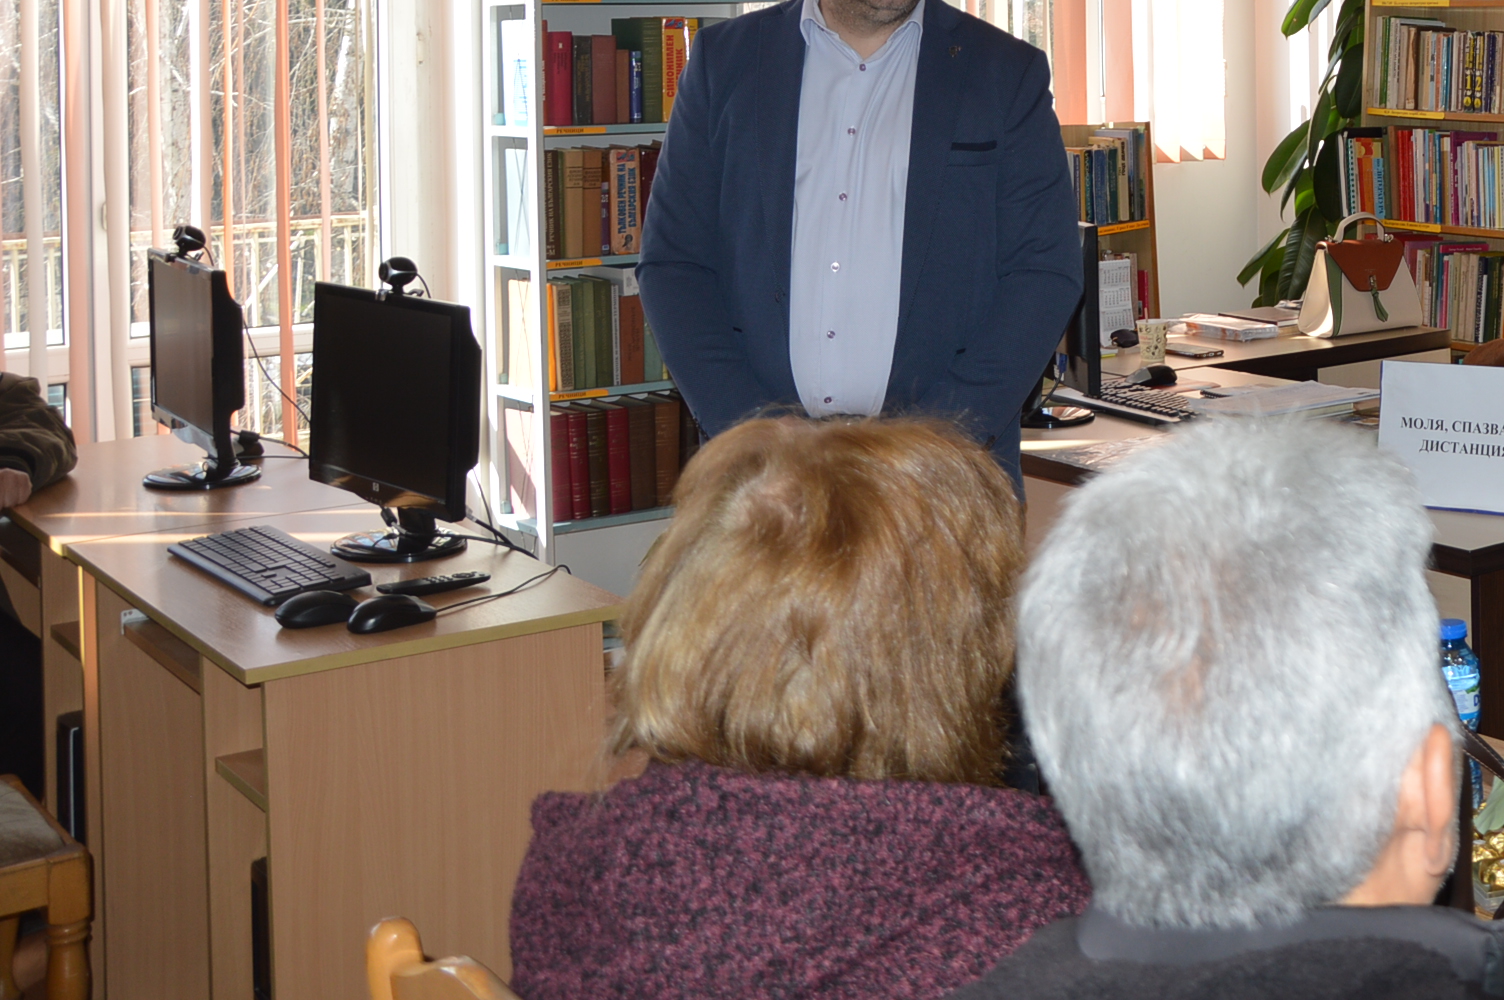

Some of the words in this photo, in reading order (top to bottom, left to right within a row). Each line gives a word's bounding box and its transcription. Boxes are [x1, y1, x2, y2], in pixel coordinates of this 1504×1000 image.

[665, 34, 675, 98] СИНОНИМЕН
[1466, 75, 1471, 90] 1
[1475, 76, 1481, 91] 2
[616, 163, 625, 172] НА
[627, 167, 636, 184] ЕЗИК
[617, 173, 626, 199] РЕЧНИК
[547, 208, 554, 216] НА
[627, 185, 637, 228] БЪЛГАРСКИЯ
[617, 200, 627, 235] ТЪЛКОВЕН
[1400, 416, 1449, 434] МОЛЯ,
